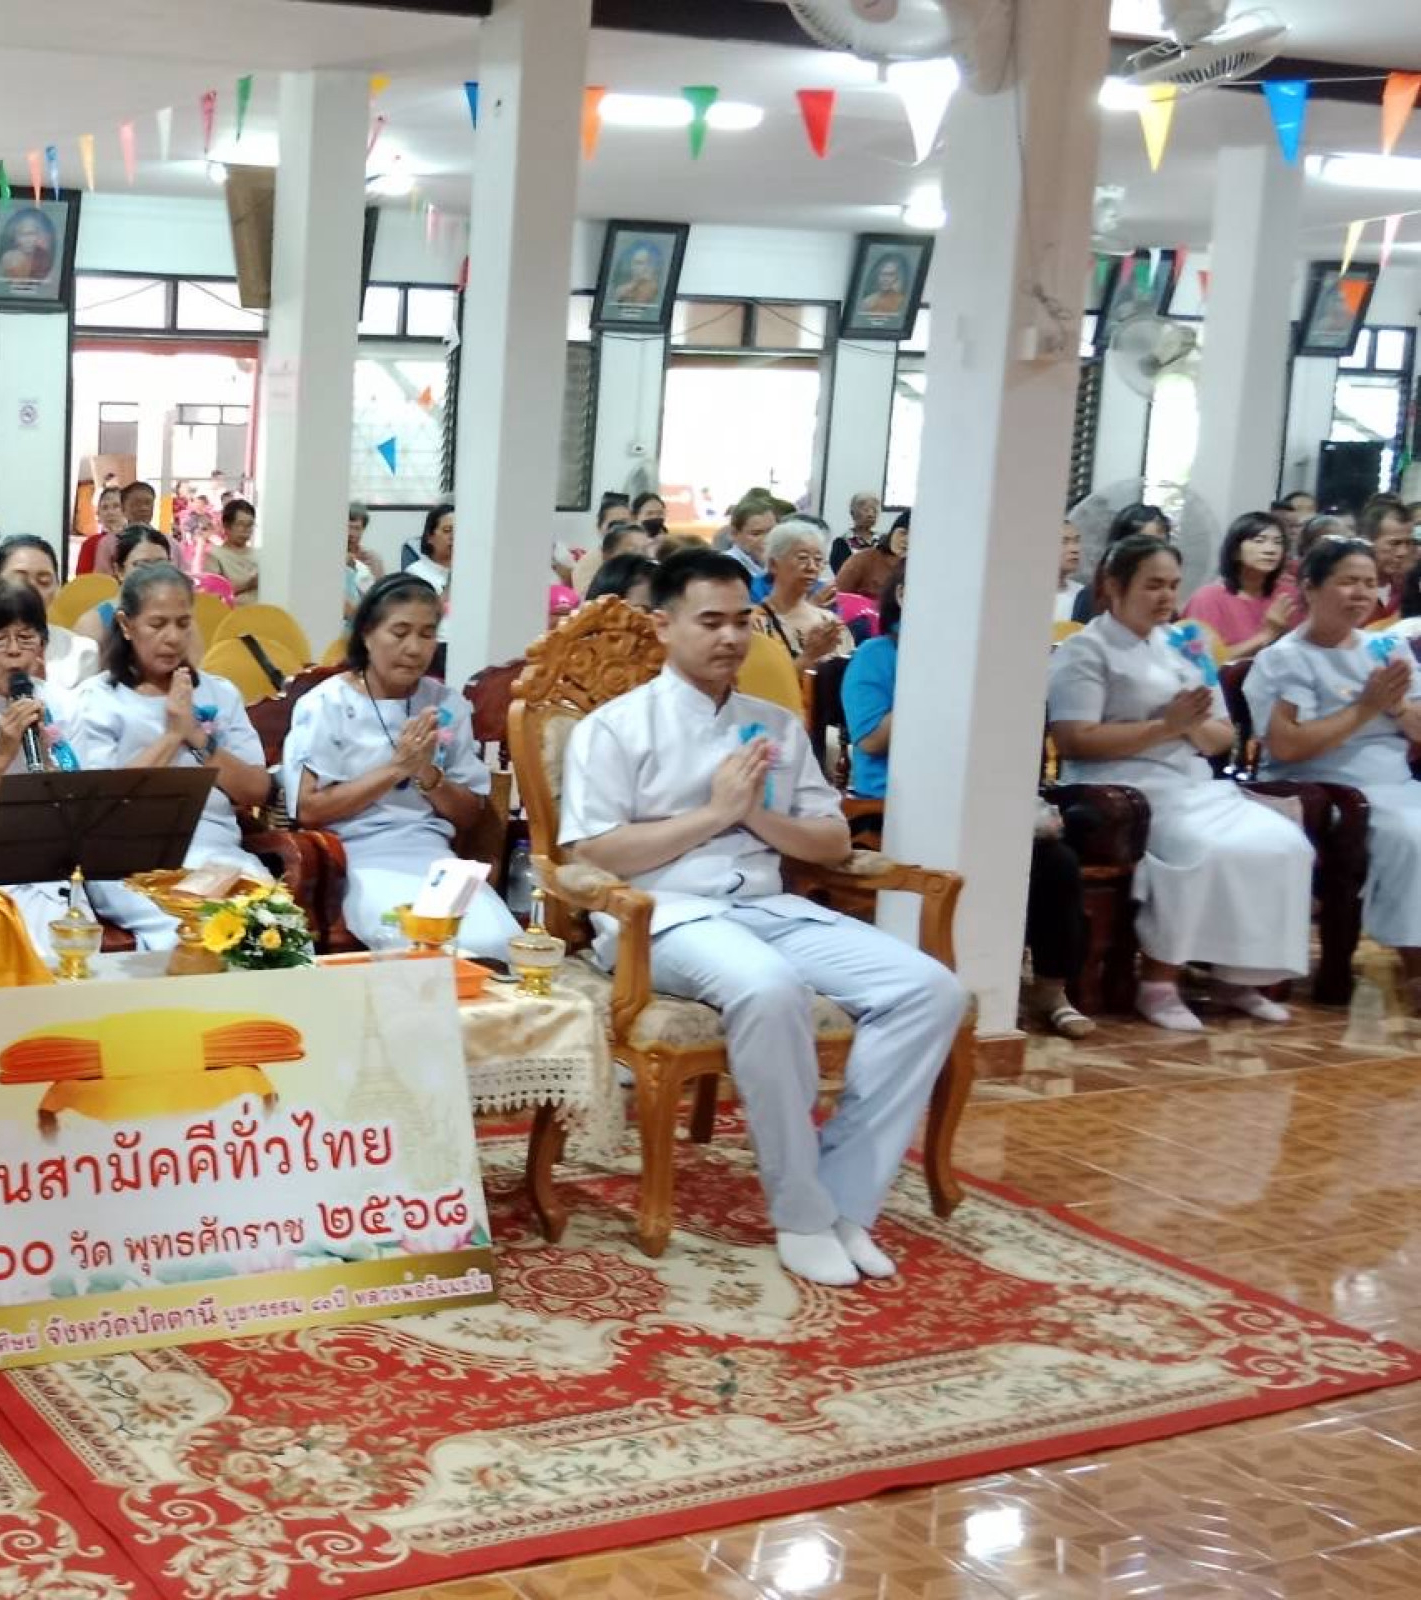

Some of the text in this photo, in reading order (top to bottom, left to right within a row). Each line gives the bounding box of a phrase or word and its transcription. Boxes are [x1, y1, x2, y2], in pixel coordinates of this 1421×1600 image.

[69, 1229, 113, 1270] วัด
[123, 1215, 305, 1276] พุทธศักราช
[317, 1187, 468, 1240] ๒๕๖๘
[45, 1295, 218, 1346] จังหวัดปัตตานี
